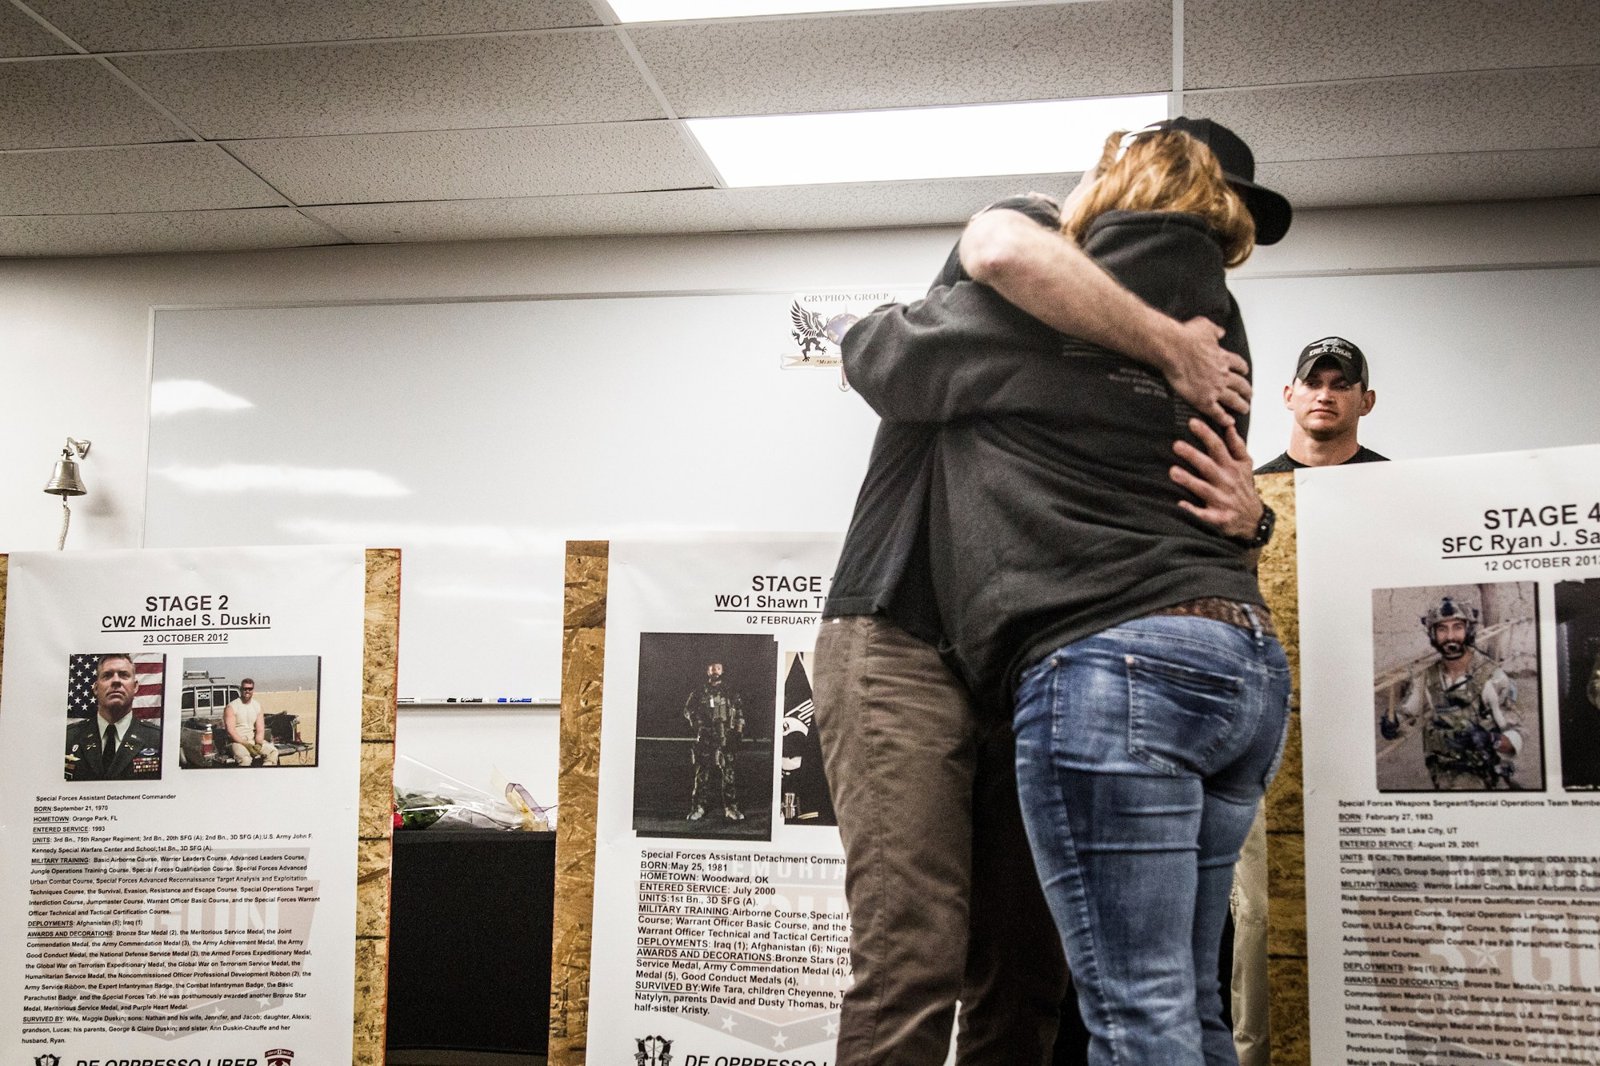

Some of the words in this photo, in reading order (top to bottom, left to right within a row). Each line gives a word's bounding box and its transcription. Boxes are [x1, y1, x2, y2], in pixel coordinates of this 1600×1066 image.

[804, 294, 851, 302] GRYPHON
[1483, 504, 1578, 530] STAGE
[1442, 536, 1483, 552] SFC
[1491, 533, 1542, 553] Ryan
[1550, 532, 1566, 546] J.
[1484, 561, 1498, 571] 12
[1503, 557, 1571, 570] OCTOBER
[1576, 555, 1600, 566] 201
[752, 576, 823, 592] STAGE
[145, 595, 212, 612] STAGE
[219, 595, 228, 610] 2
[715, 595, 751, 607] WO1
[757, 596, 808, 608] Shawn
[102, 616, 136, 628] CW2
[141, 614, 196, 627] Michael
[201, 614, 215, 626] S.
[221, 612, 270, 626] Duskin
[746, 616, 758, 624] 02
[761, 616, 817, 625] FEBRUARY
[641, 850, 673, 861] Special
[676, 852, 706, 860] Forces
[709, 852, 752, 862] Assistant
[754, 854, 808, 864] Detachment
[707, 864, 728, 872] 1981
[640, 883, 684, 891] ENTERED
[733, 886, 752, 896] July
[639, 904, 682, 913] MILITARY
[675, 917, 711, 926] Warrant
[714, 919, 744, 927] Officer
[747, 920, 772, 928] Basic
[637, 926, 673, 935] Warrant
[675, 928, 705, 937] Officer
[707, 929, 750, 938] Technical
[753, 931, 770, 939] and
[772, 932, 807, 941] Tactical
[637, 948, 678, 957] AWARDS
[714, 940, 731, 950] Iraq
[751, 942, 806, 954] Afghanistan
[636, 960, 669, 968] Service
[704, 963, 728, 972] Army
[730, 964, 799, 974] Commendation
[802, 967, 829, 975] Medal
[636, 970, 662, 979] Medal
[682, 972, 706, 981] Good
[709, 973, 747, 983] Conduct
[750, 975, 782, 984] Medals
[635, 981, 683, 990] SURVIVED
[748, 986, 785, 995] children
[635, 1003, 679, 1013] half-sister
[674, 995, 708, 1005] parents
[710, 996, 736, 1004] David
[738, 997, 755, 1005] and
[758, 998, 785, 1008] Dusty
[685, 1055, 710, 1066] DE
